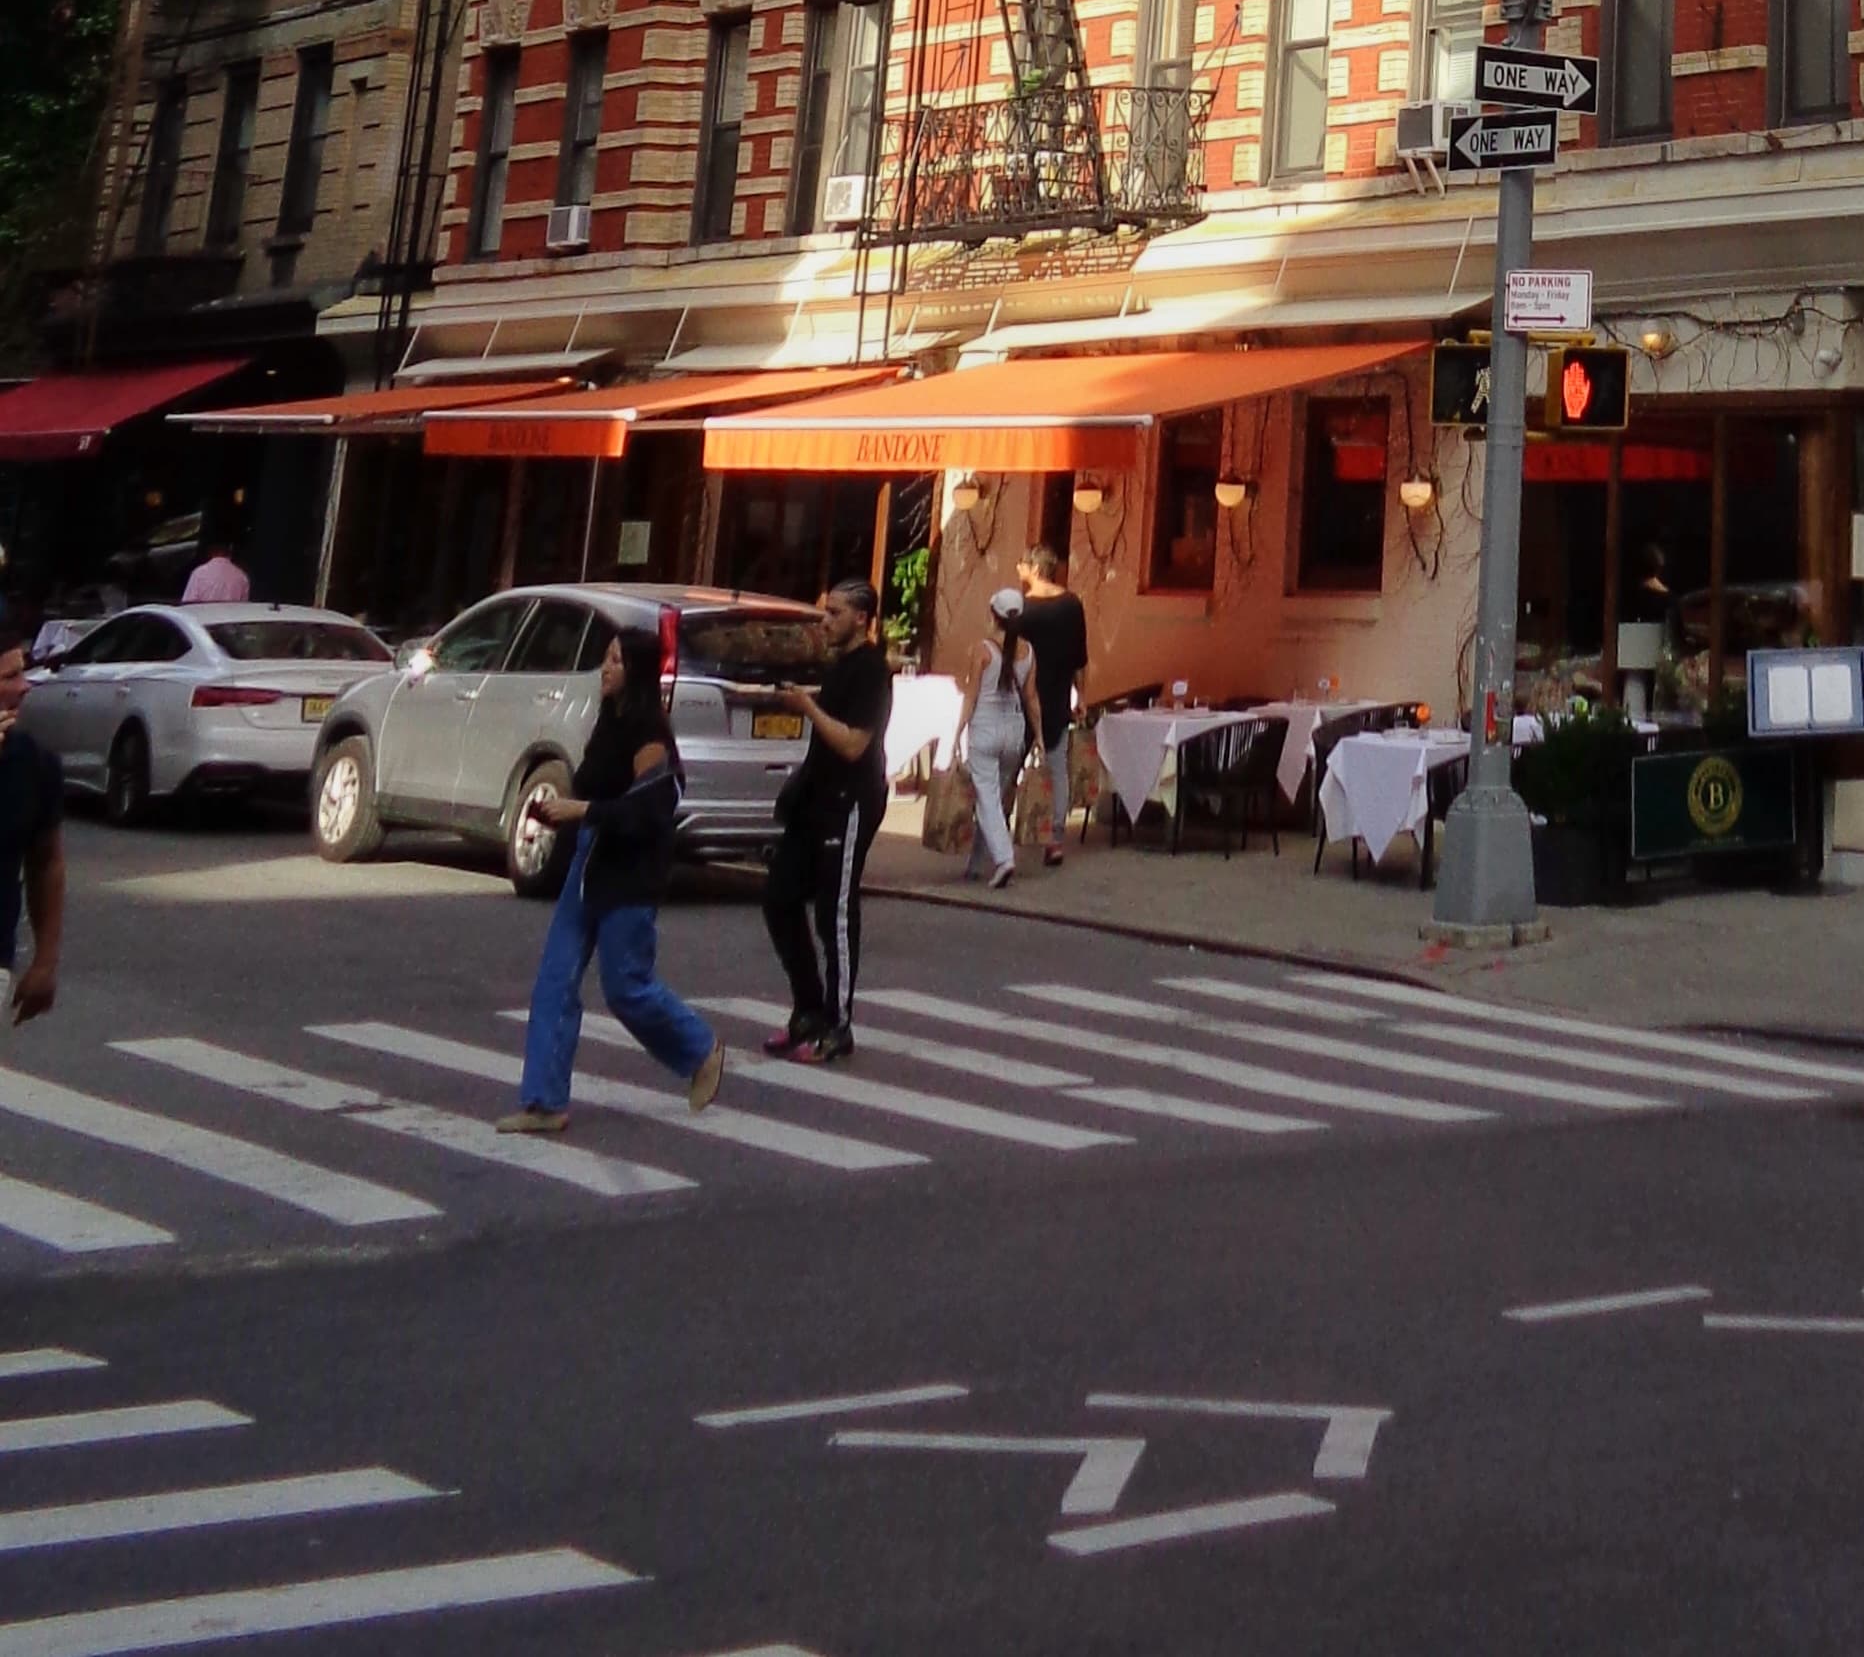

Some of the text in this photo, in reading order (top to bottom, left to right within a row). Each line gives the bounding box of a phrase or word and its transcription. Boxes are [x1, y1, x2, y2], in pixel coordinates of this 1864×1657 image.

[1494, 65, 1580, 94] ONE WAY
[1470, 129, 1544, 153] ONE WAY
[1512, 277, 1571, 287] NO PARKING
[856, 433, 946, 463] BANDONE
